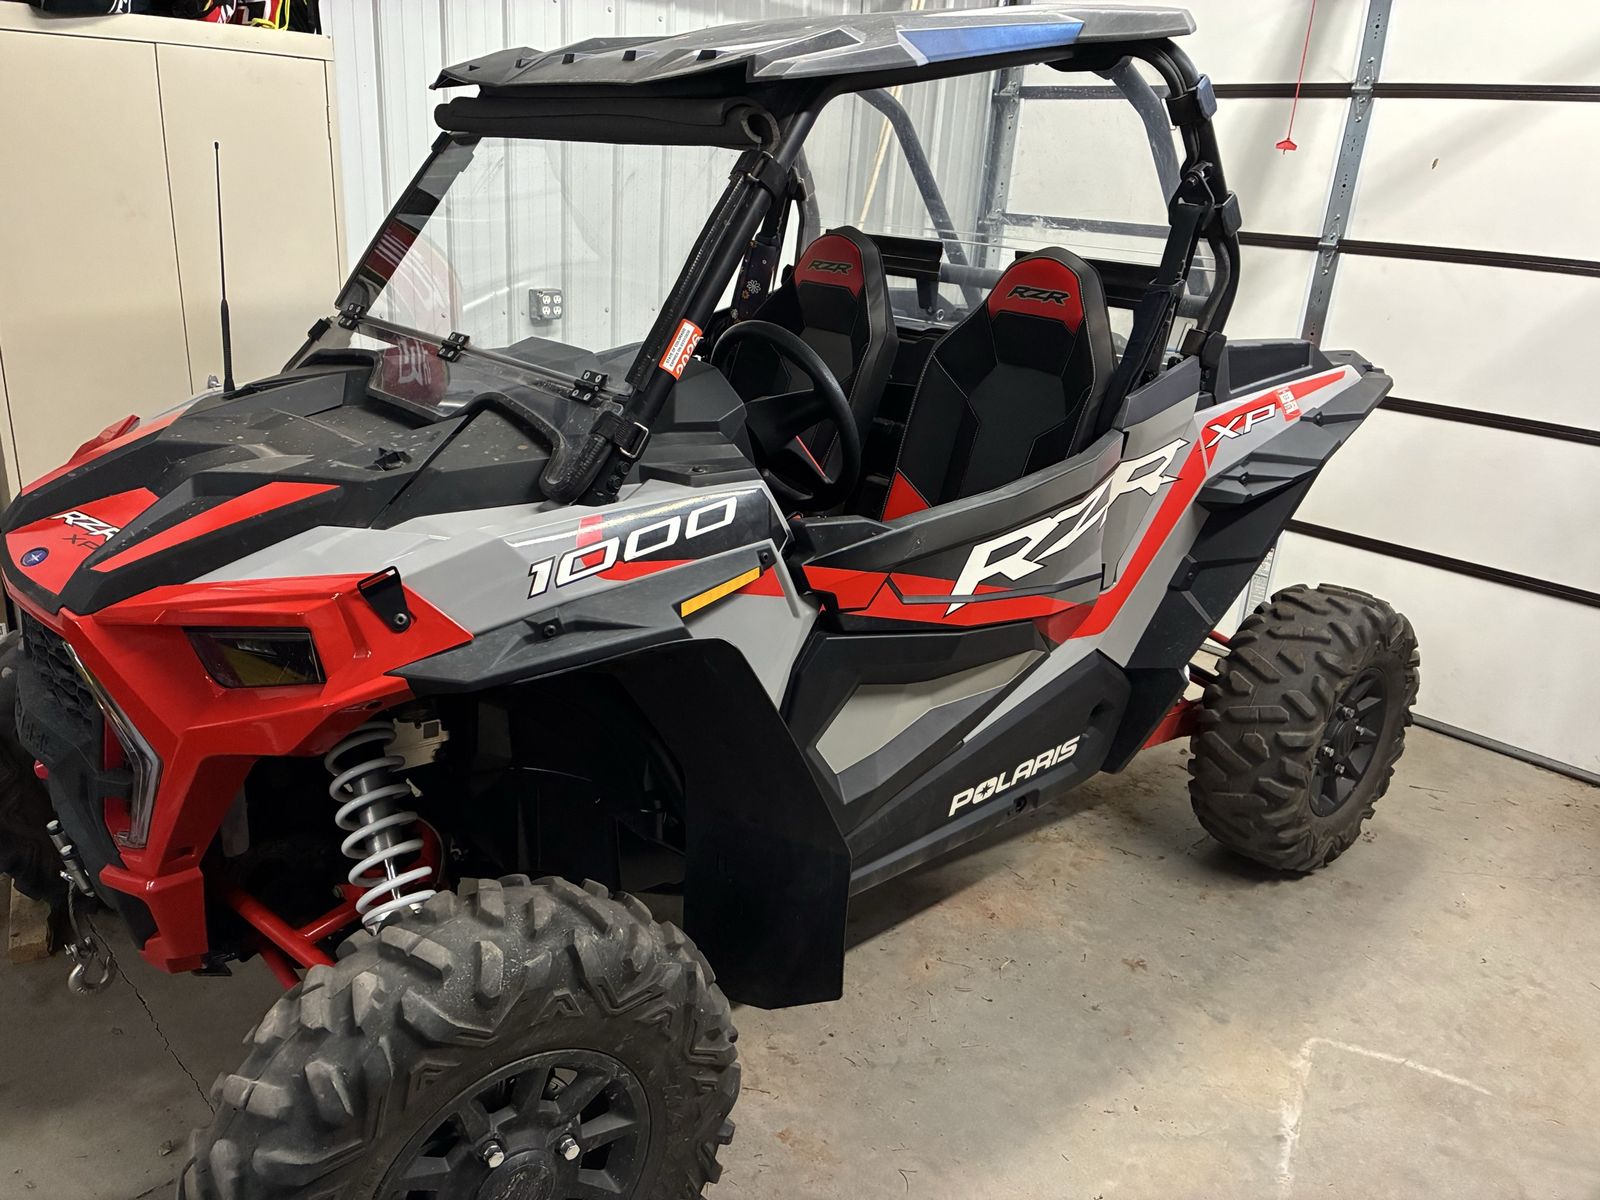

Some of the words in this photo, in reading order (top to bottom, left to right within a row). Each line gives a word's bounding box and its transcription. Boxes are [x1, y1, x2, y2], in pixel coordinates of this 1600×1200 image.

[807, 259, 854, 275] RZR
[1006, 285, 1071, 306] RZR
[1199, 402, 1277, 451] XP
[528, 496, 738, 600] 1000
[942, 437, 1190, 619] RZR
[948, 735, 1081, 817] POLARIS
